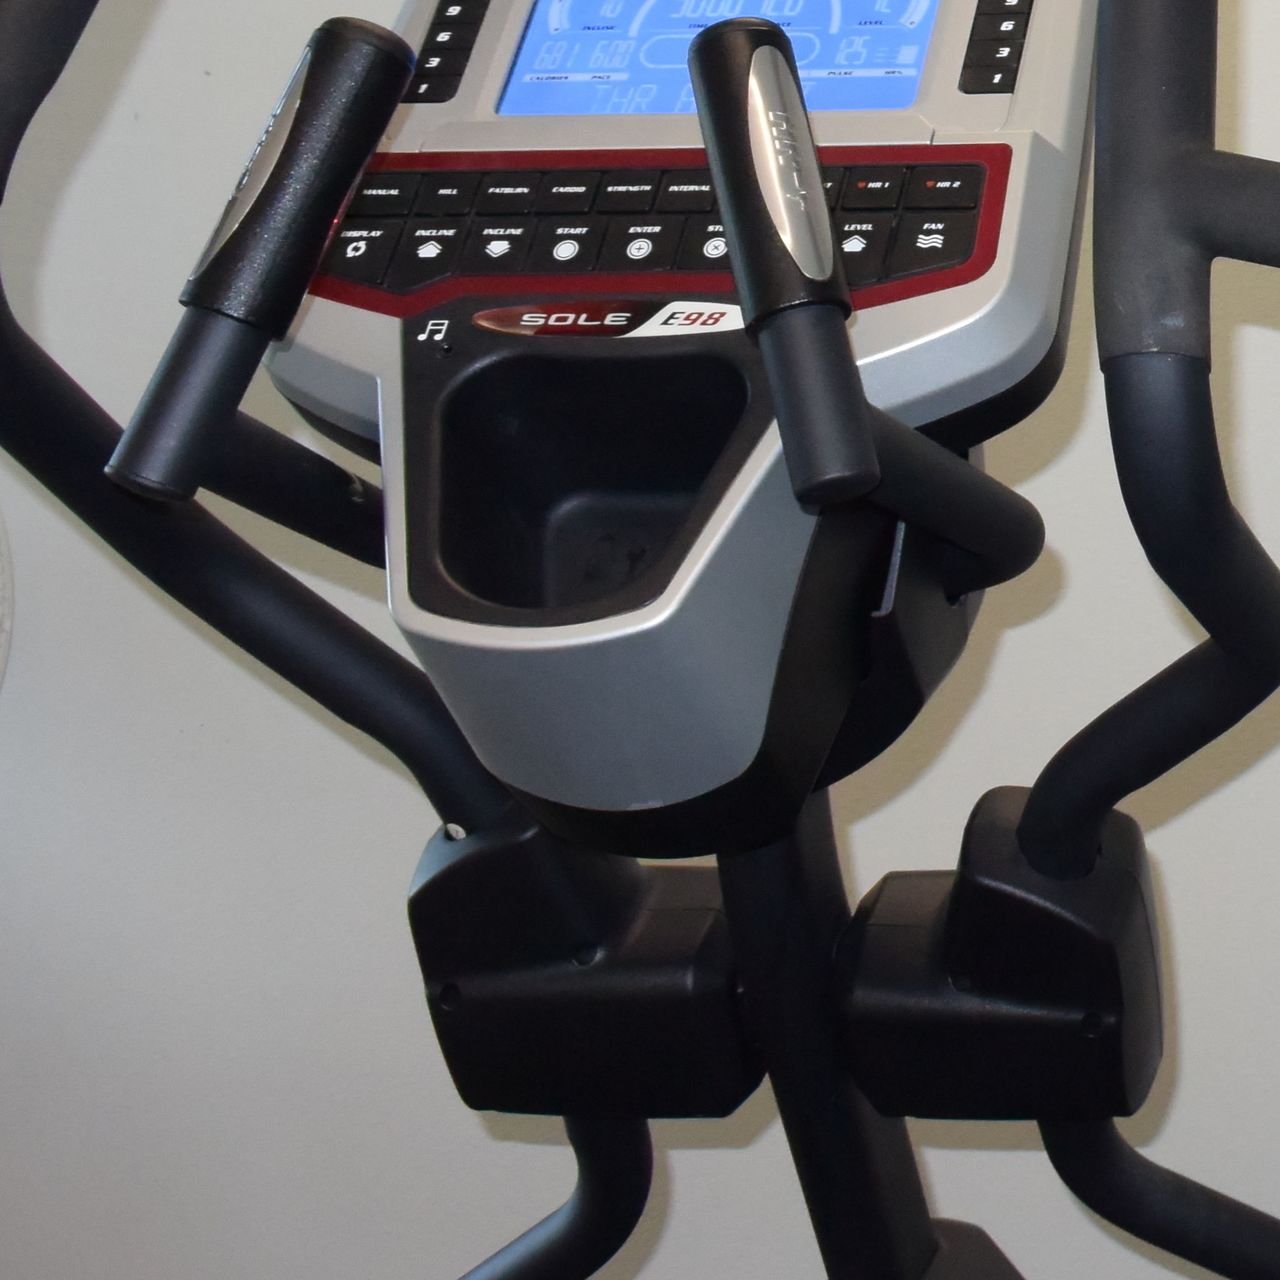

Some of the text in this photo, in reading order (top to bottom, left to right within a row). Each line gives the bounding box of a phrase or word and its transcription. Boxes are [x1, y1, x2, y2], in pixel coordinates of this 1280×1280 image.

[445, 6, 462, 16] 9
[1000, 21, 1016, 31] 6
[436, 32, 453, 42] 6
[995, 47, 1011, 58] 3
[424, 57, 442, 67] 3
[992, 73, 1003, 83] 1
[418, 84, 429, 94] 1
[341, 230, 383, 238] DISPLAY
[555, 227, 589, 235] START
[520, 313, 631, 326] SOLE
[660, 312, 727, 326] E98
